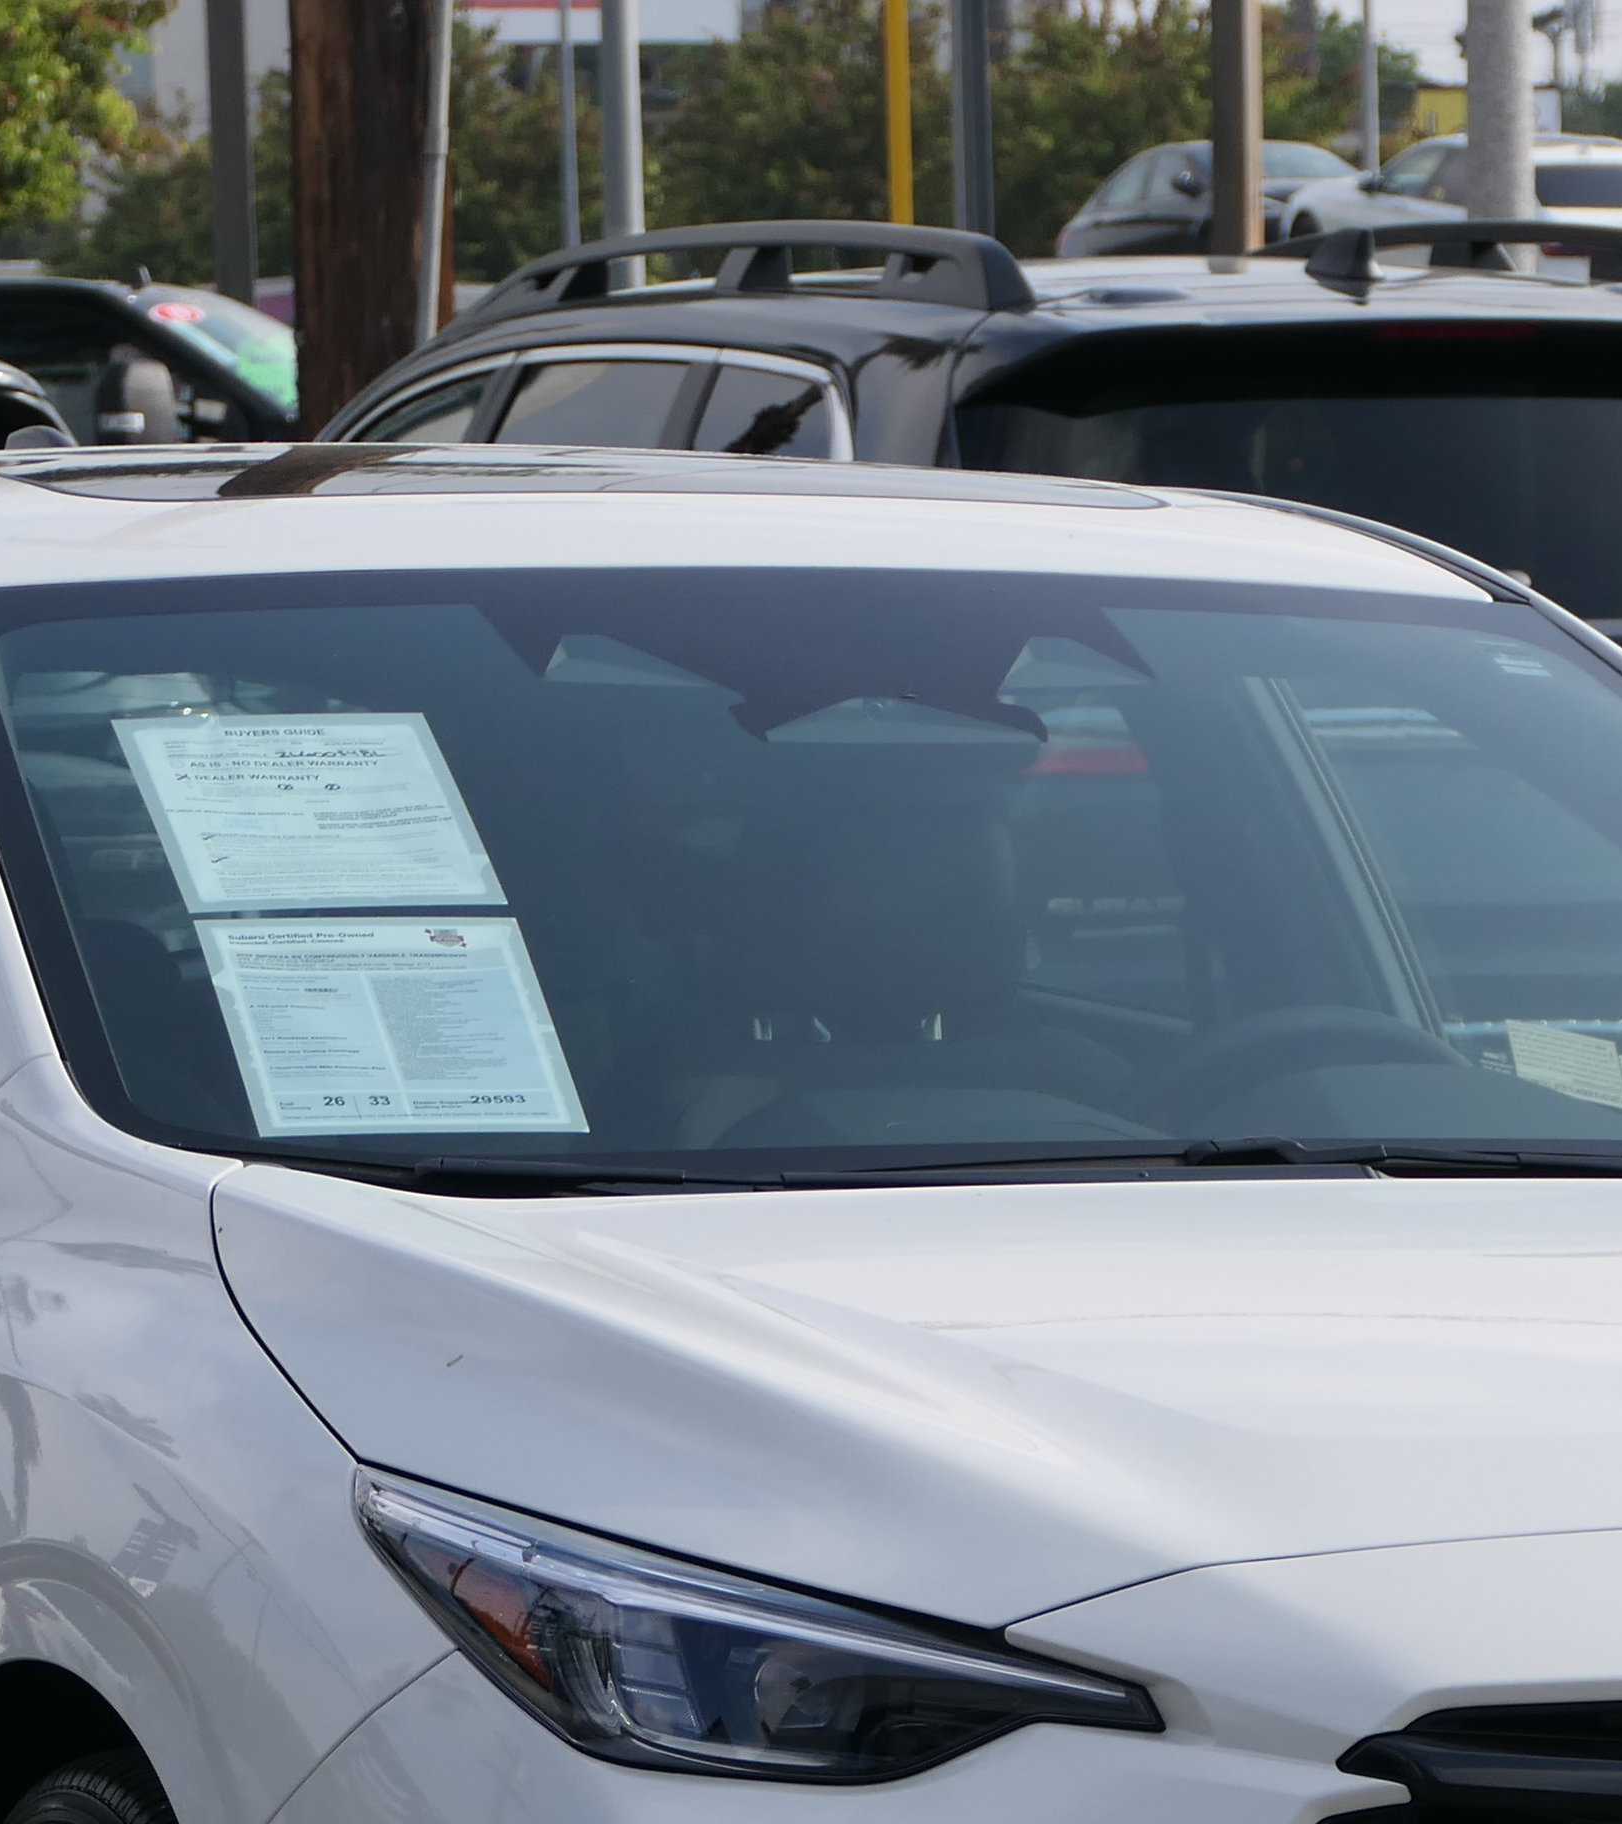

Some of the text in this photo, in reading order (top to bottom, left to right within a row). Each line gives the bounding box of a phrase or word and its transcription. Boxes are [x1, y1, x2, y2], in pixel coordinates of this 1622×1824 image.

[224, 728, 326, 737] BUYERS GUIDE
[190, 760, 207, 768] AS
[254, 760, 305, 768] DEALER
[307, 759, 379, 767] WARRANTY
[194, 773, 321, 781] DEALER WARRANTY
[267, 932, 314, 941] Certified
[315, 931, 375, 939] Pre-Owned
[322, 1096, 346, 1107] 26
[368, 1095, 391, 1106] 33
[470, 1094, 527, 1105] 29593
